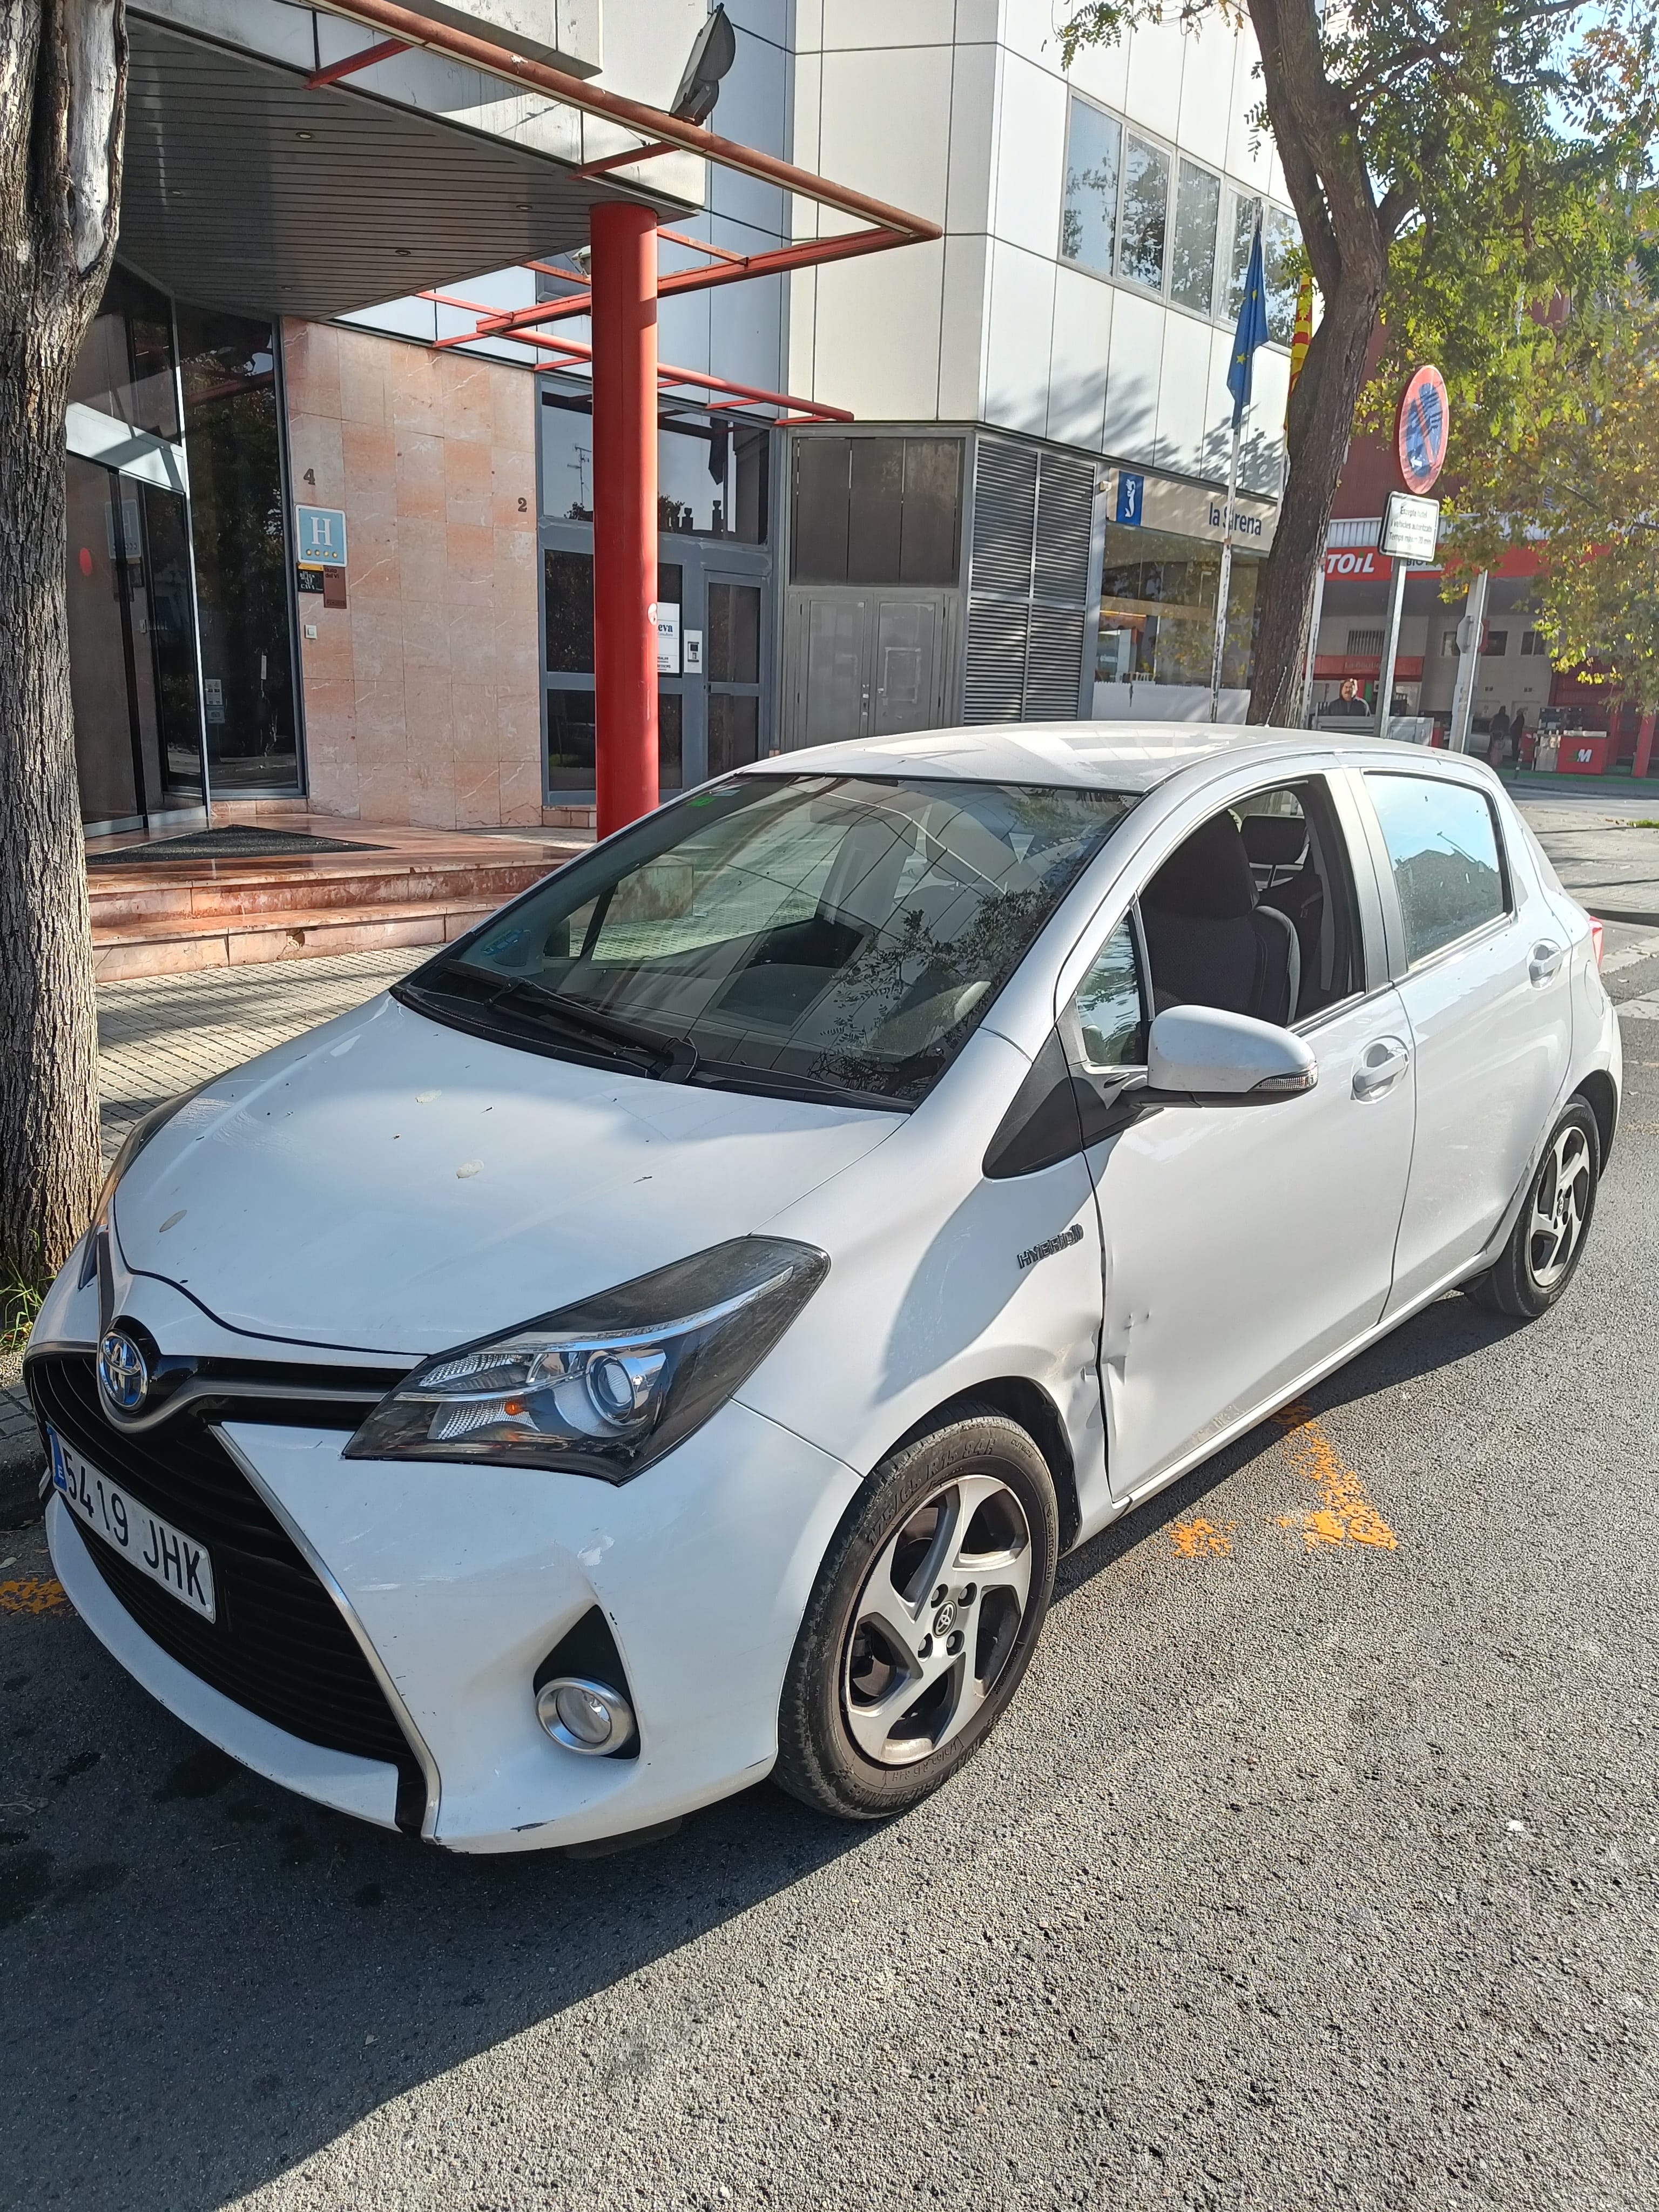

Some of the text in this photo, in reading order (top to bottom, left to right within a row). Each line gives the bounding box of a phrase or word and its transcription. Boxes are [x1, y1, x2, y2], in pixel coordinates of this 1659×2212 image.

[304, 468, 315, 485] 4
[518, 497, 527, 512] 2
[1209, 502, 1220, 527] la
[311, 517, 333, 546] H
[1406, 558, 1428, 567] BIO
[1017, 1229, 1076, 1269] HYBRID
[58, 1447, 206, 1606] E 5419 JHK
